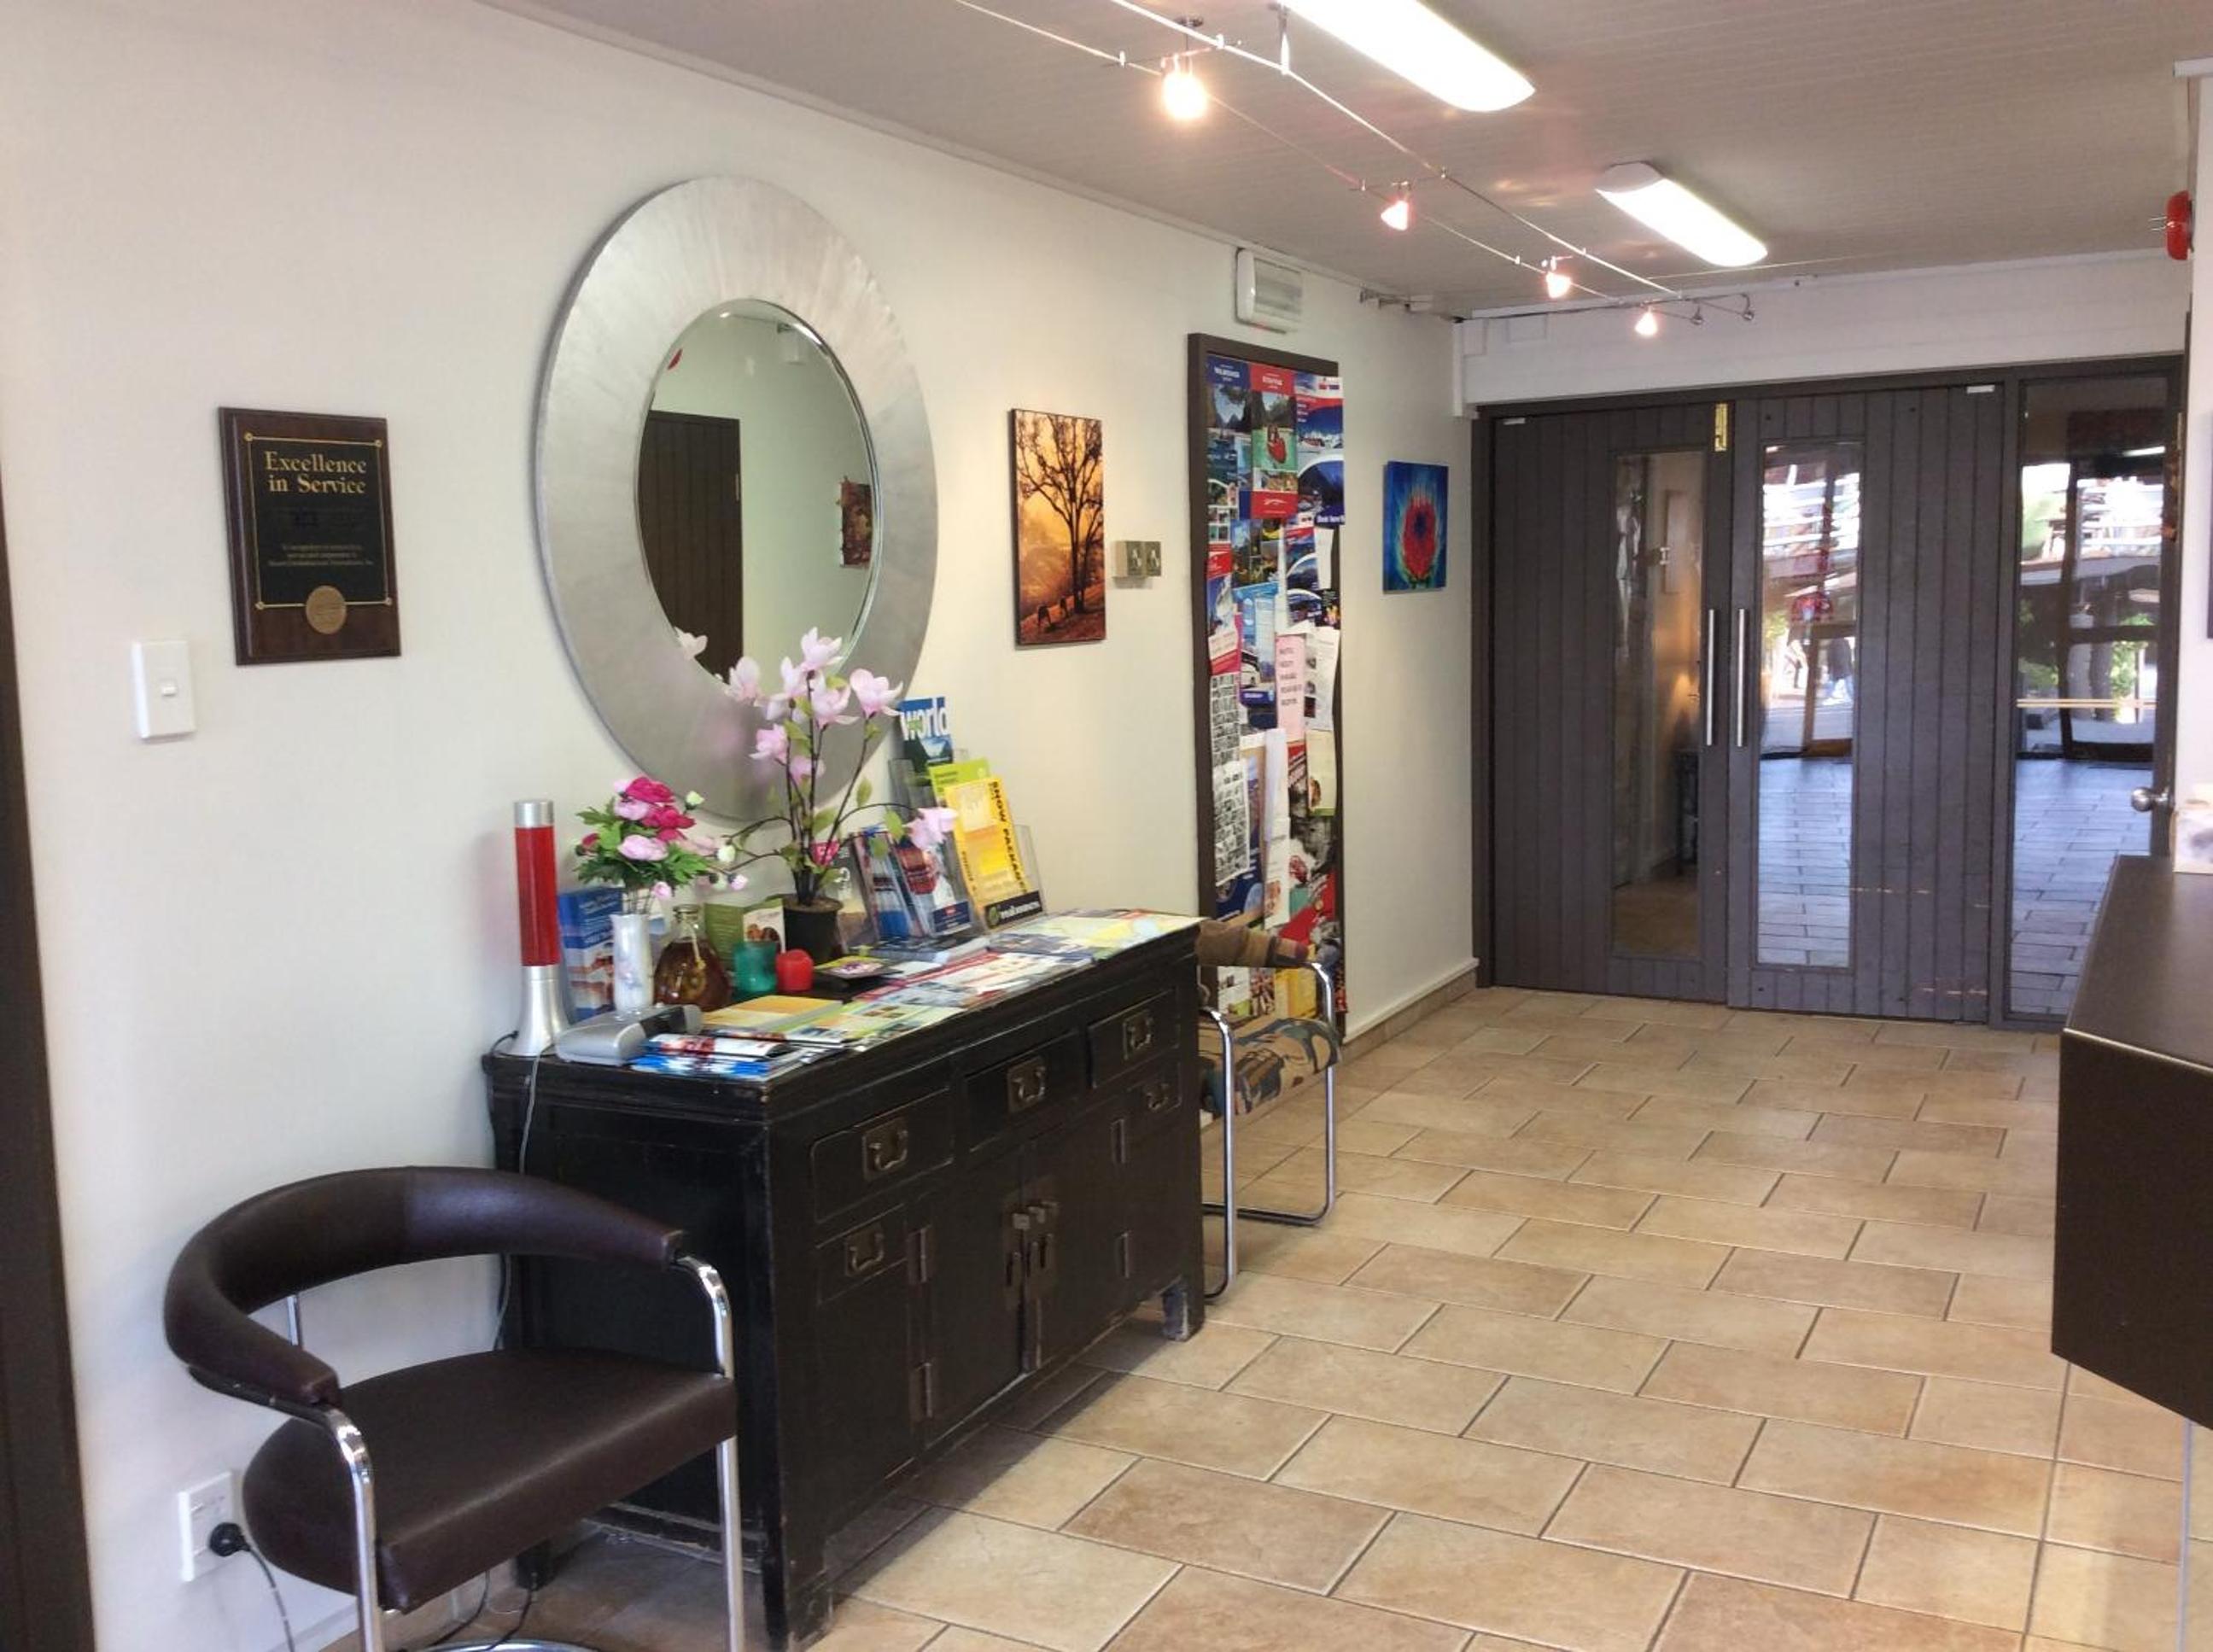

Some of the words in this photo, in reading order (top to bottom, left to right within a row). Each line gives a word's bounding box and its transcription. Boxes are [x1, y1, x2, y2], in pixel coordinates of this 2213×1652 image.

[265, 451, 367, 474] Excellence
[268, 475, 288, 493] in
[297, 475, 366, 494] Service
[900, 698, 950, 741] world
